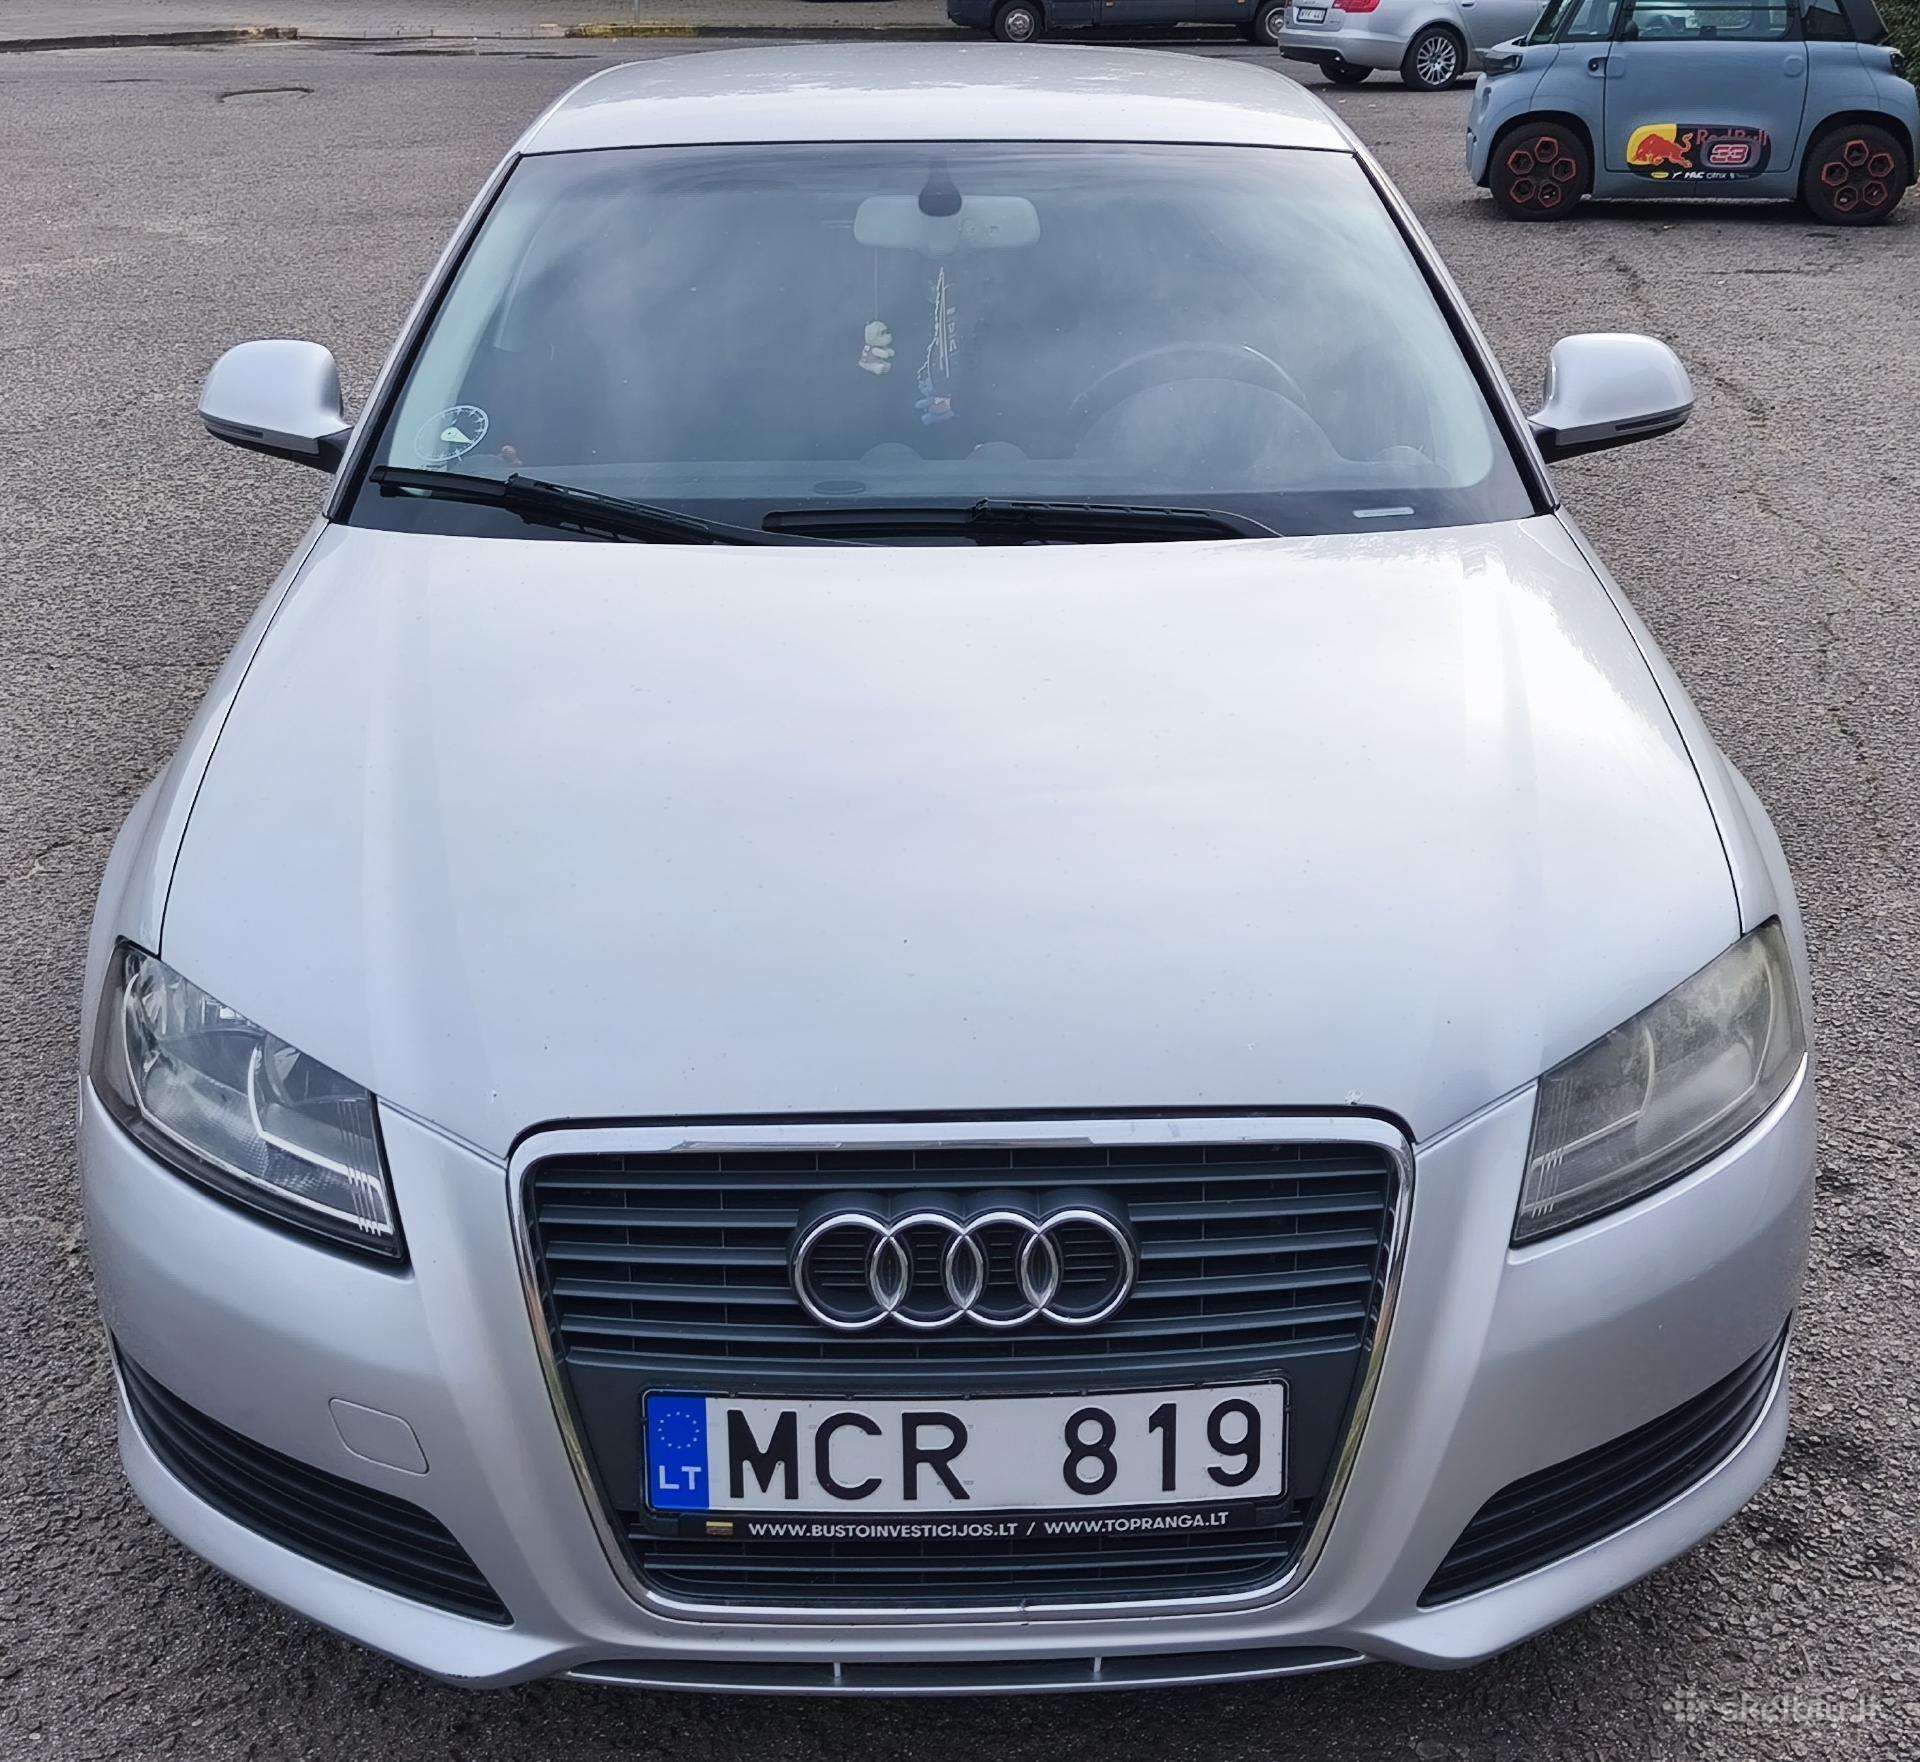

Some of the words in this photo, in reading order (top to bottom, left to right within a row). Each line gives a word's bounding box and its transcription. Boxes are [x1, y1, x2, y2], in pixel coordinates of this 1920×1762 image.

[1735, 128, 1768, 146] Bll
[727, 1409, 970, 1500] MCR
[1063, 1398, 1261, 1496] 819
[658, 1465, 702, 1490] LT
[748, 1521, 1019, 1538] WWW.BUSTOINVESTICIJOS.LT
[1026, 1521, 1036, 1537] /
[1044, 1511, 1229, 1535] WWW.TOPRANGA.LT
